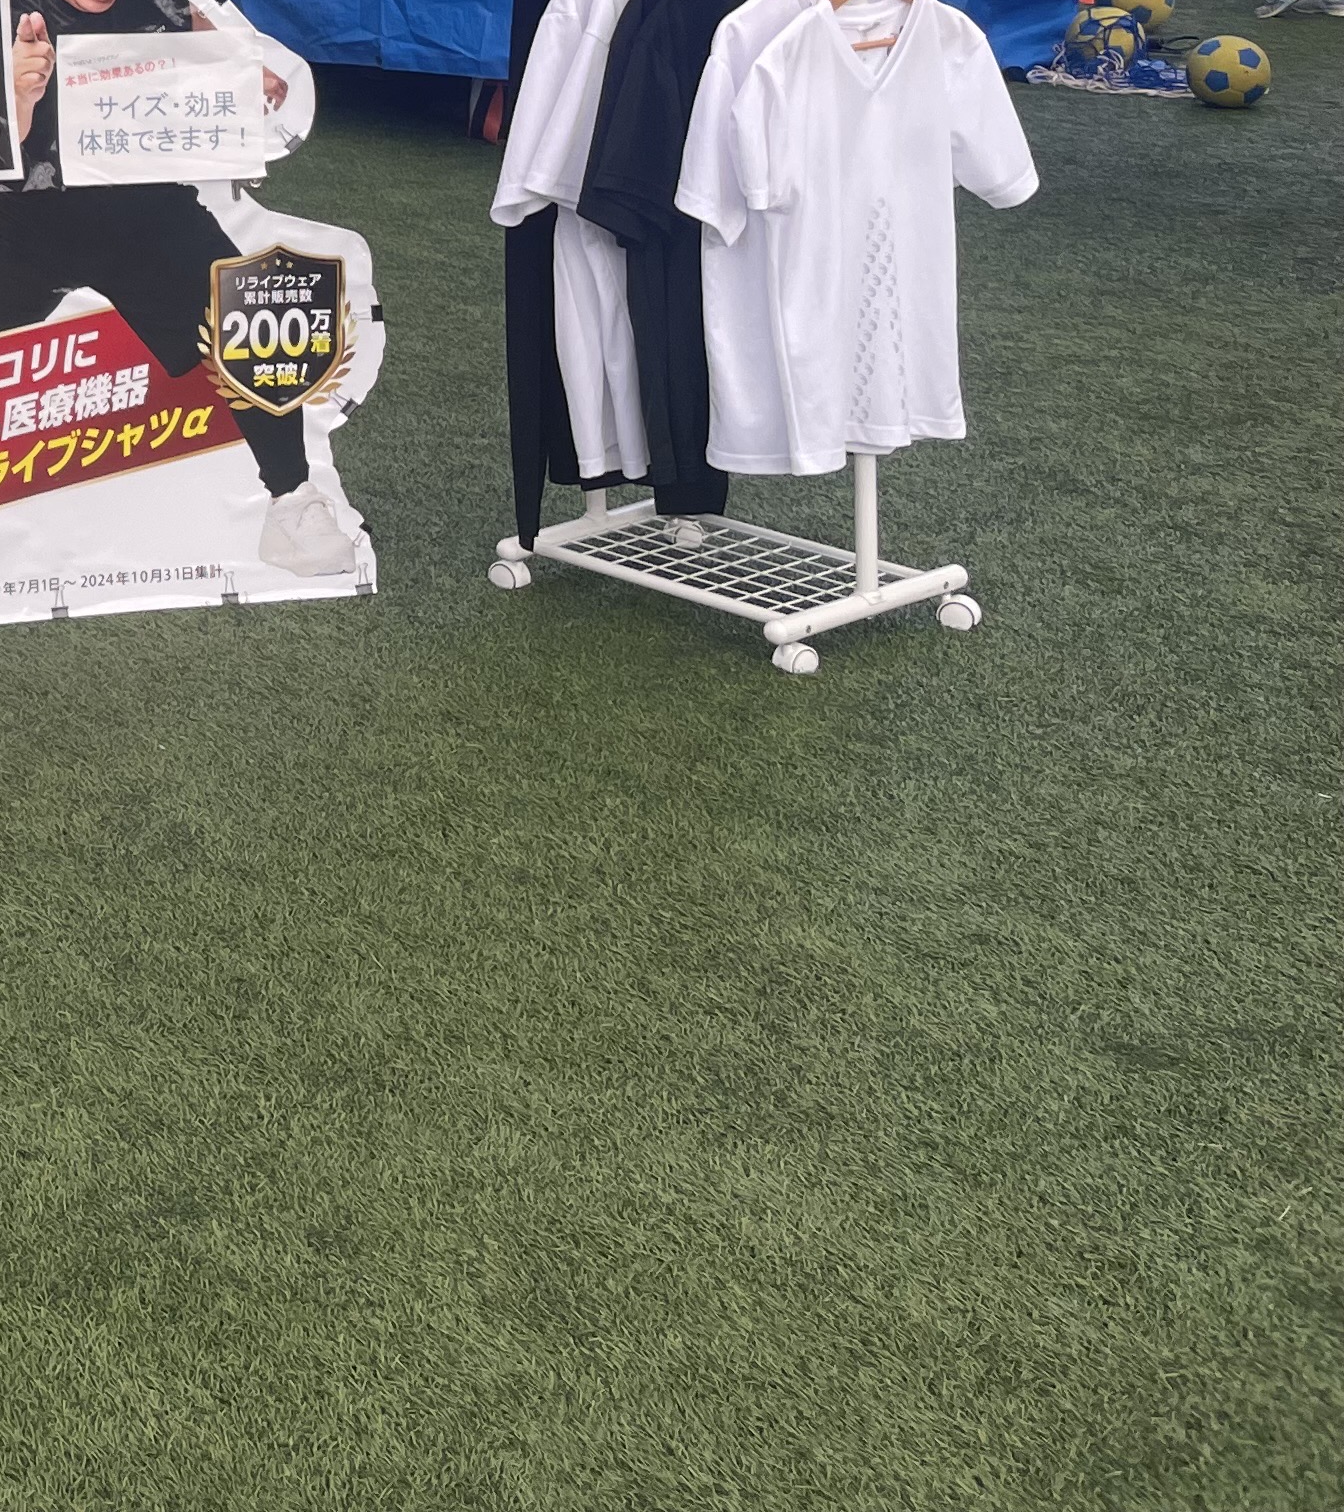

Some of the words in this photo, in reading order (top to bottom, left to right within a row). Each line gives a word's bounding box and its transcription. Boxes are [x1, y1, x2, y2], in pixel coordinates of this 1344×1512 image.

[94, 91, 237, 120] サイズ・効果
[77, 125, 245, 156] 体験できます！
[235, 273, 322, 290] リライブウェア
[244, 288, 313, 305] 累計販売数
